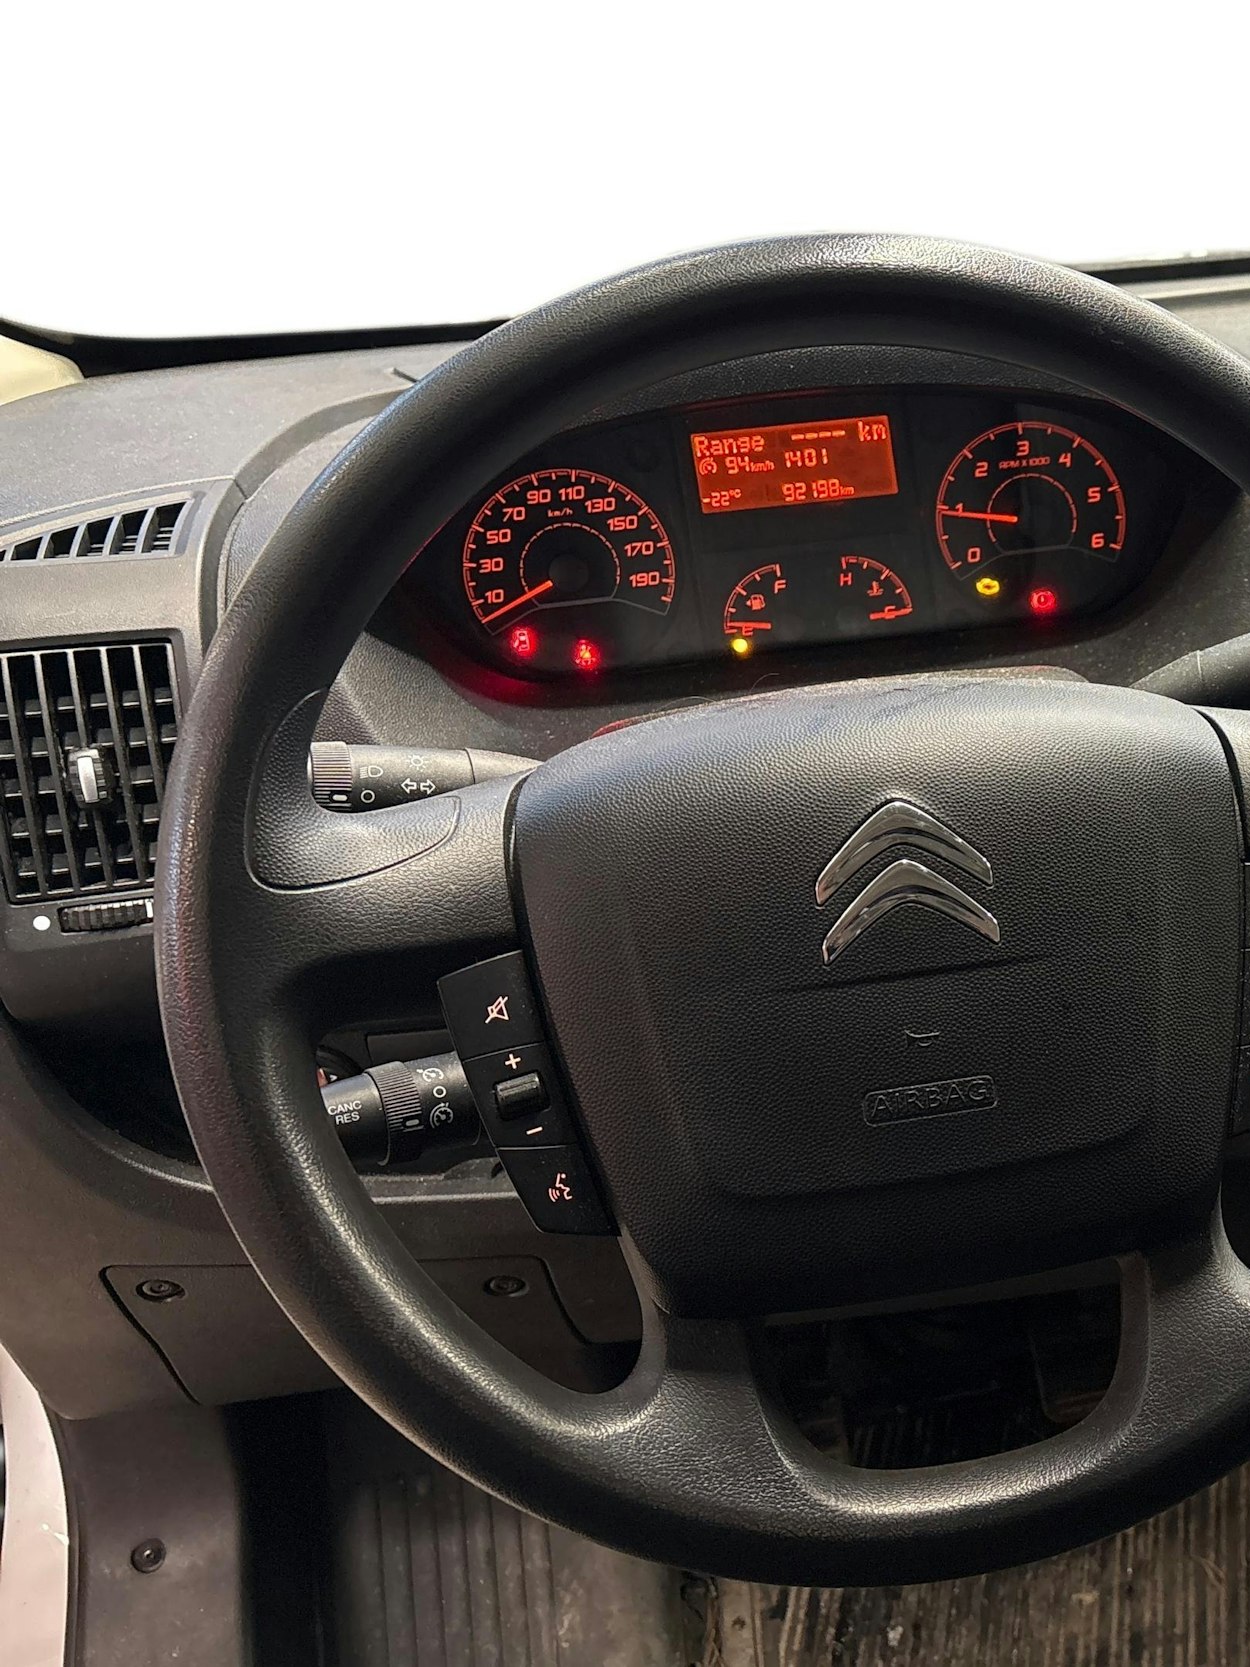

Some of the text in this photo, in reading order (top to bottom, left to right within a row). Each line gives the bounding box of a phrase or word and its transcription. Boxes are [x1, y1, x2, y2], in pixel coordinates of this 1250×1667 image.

[693, 435, 765, 457] Range
[857, 420, 887, 441] km
[1016, 440, 1030, 457] 3
[998, 459, 1020, 469] RPM
[1028, 456, 1051, 467] 1000
[1058, 452, 1072, 468] 4
[974, 461, 989, 478] 2
[526, 489, 551, 505] 90
[558, 485, 585, 501] 110
[1087, 486, 1102, 503] 5
[547, 508, 573, 518] km/h
[584, 497, 616, 514] 130
[502, 506, 526, 522] 70
[607, 515, 638, 531] 150
[486, 529, 511, 545] 50
[1091, 532, 1105, 549] 6
[624, 541, 654, 557] 170
[967, 547, 981, 563] 0
[479, 557, 504, 573] 30
[629, 571, 660, 588] 190
[774, 579, 787, 594] F
[840, 572, 852, 587] H
[485, 589, 504, 604] 10
[870, 1079, 988, 1117] AIRBAG
[327, 1100, 362, 1115] CANC
[335, 1111, 360, 1125] RES
